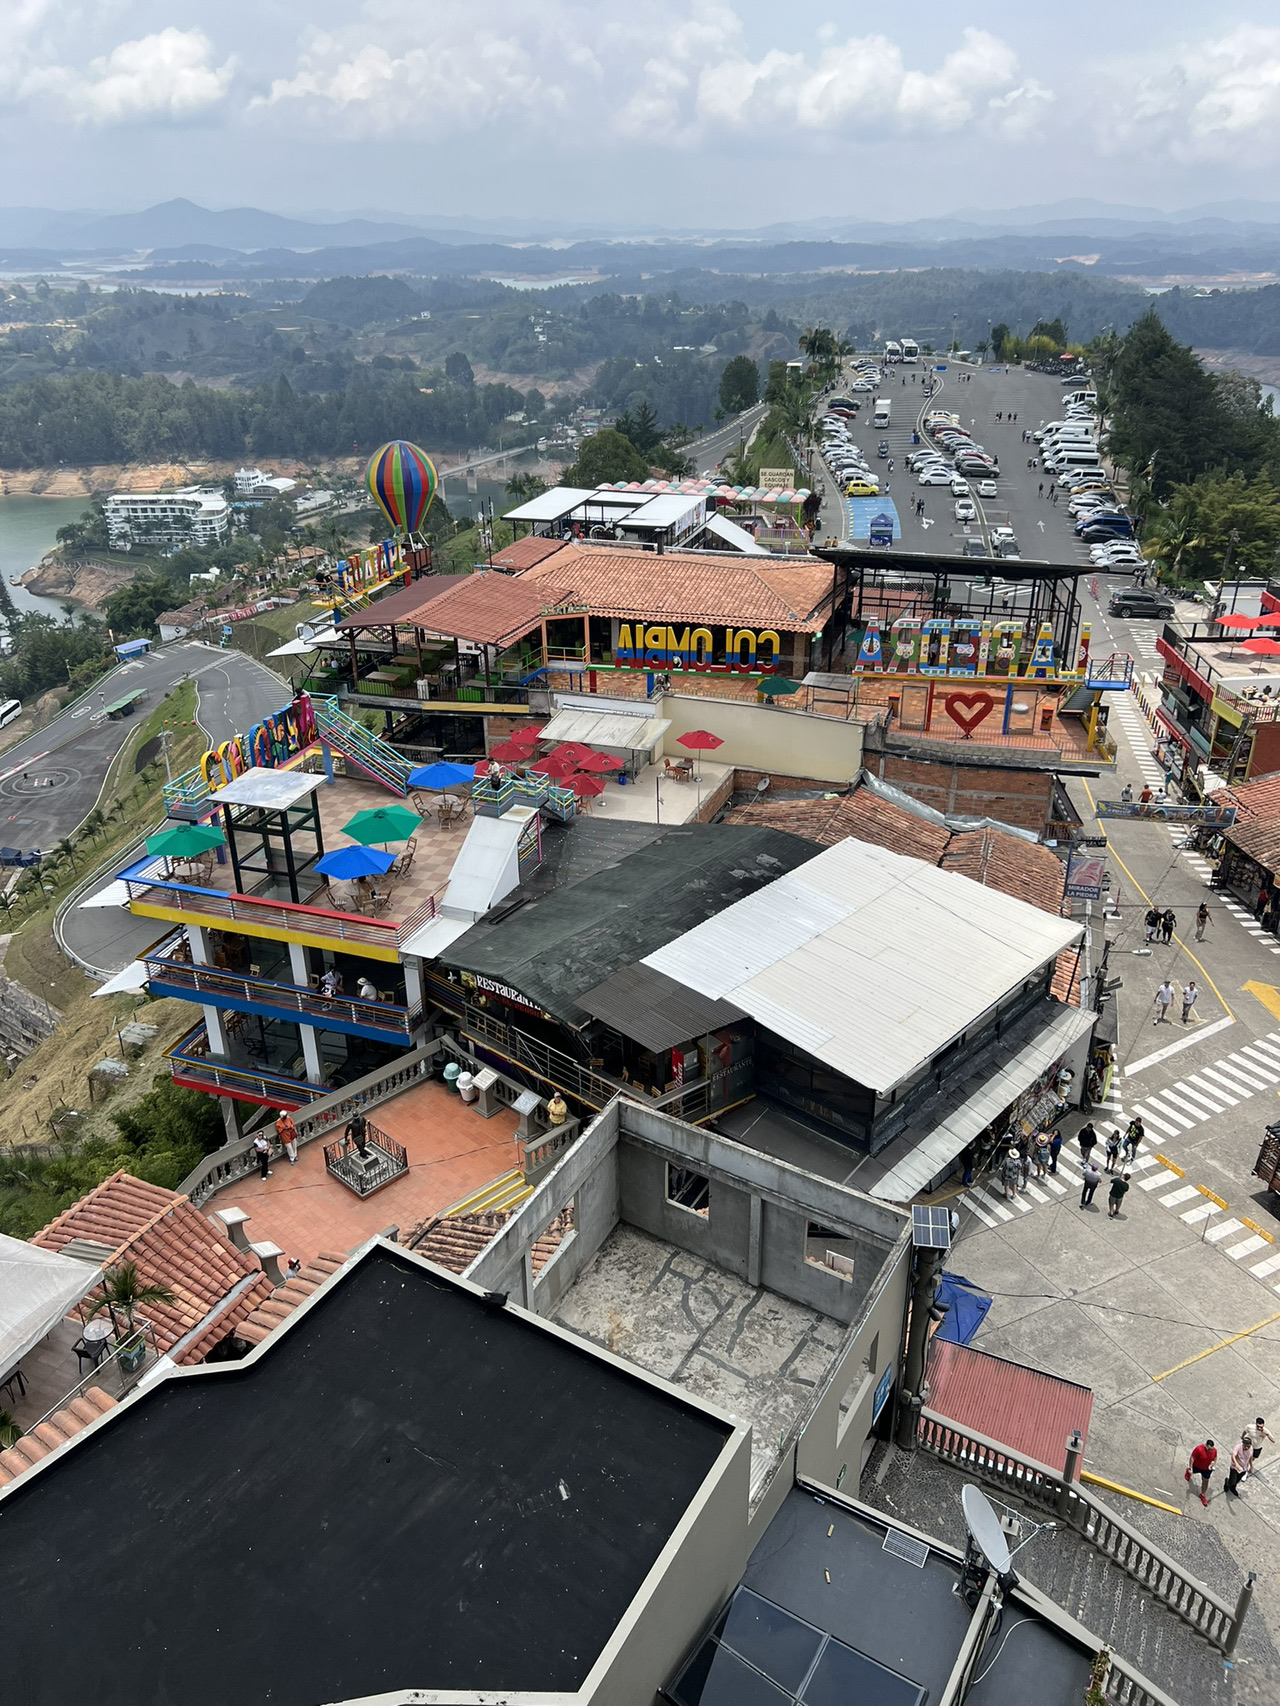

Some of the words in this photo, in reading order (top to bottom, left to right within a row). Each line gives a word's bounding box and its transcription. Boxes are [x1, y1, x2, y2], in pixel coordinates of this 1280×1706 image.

[1068, 885, 1099, 893] MIRADOR
[1076, 891, 1098, 899] PIEDRA
[712, 1056, 753, 1081] RESTAURANTE
